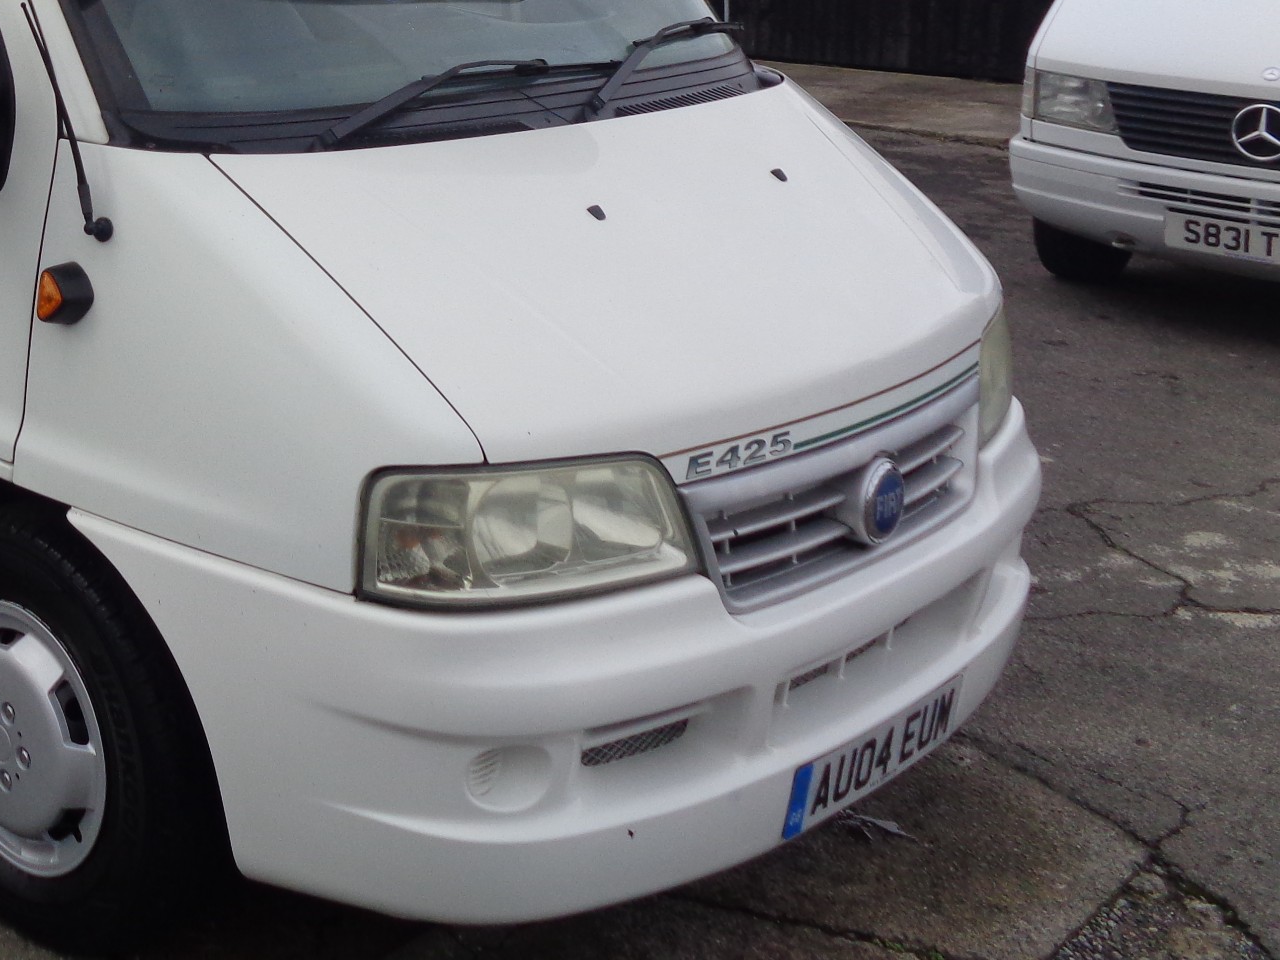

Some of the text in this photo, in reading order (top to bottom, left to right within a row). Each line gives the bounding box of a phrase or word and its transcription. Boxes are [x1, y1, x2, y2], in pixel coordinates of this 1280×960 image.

[1184, 219, 1250, 253] S831
[685, 430, 793, 480] E425
[876, 487, 901, 520] FIAT
[810, 726, 895, 816] AU04
